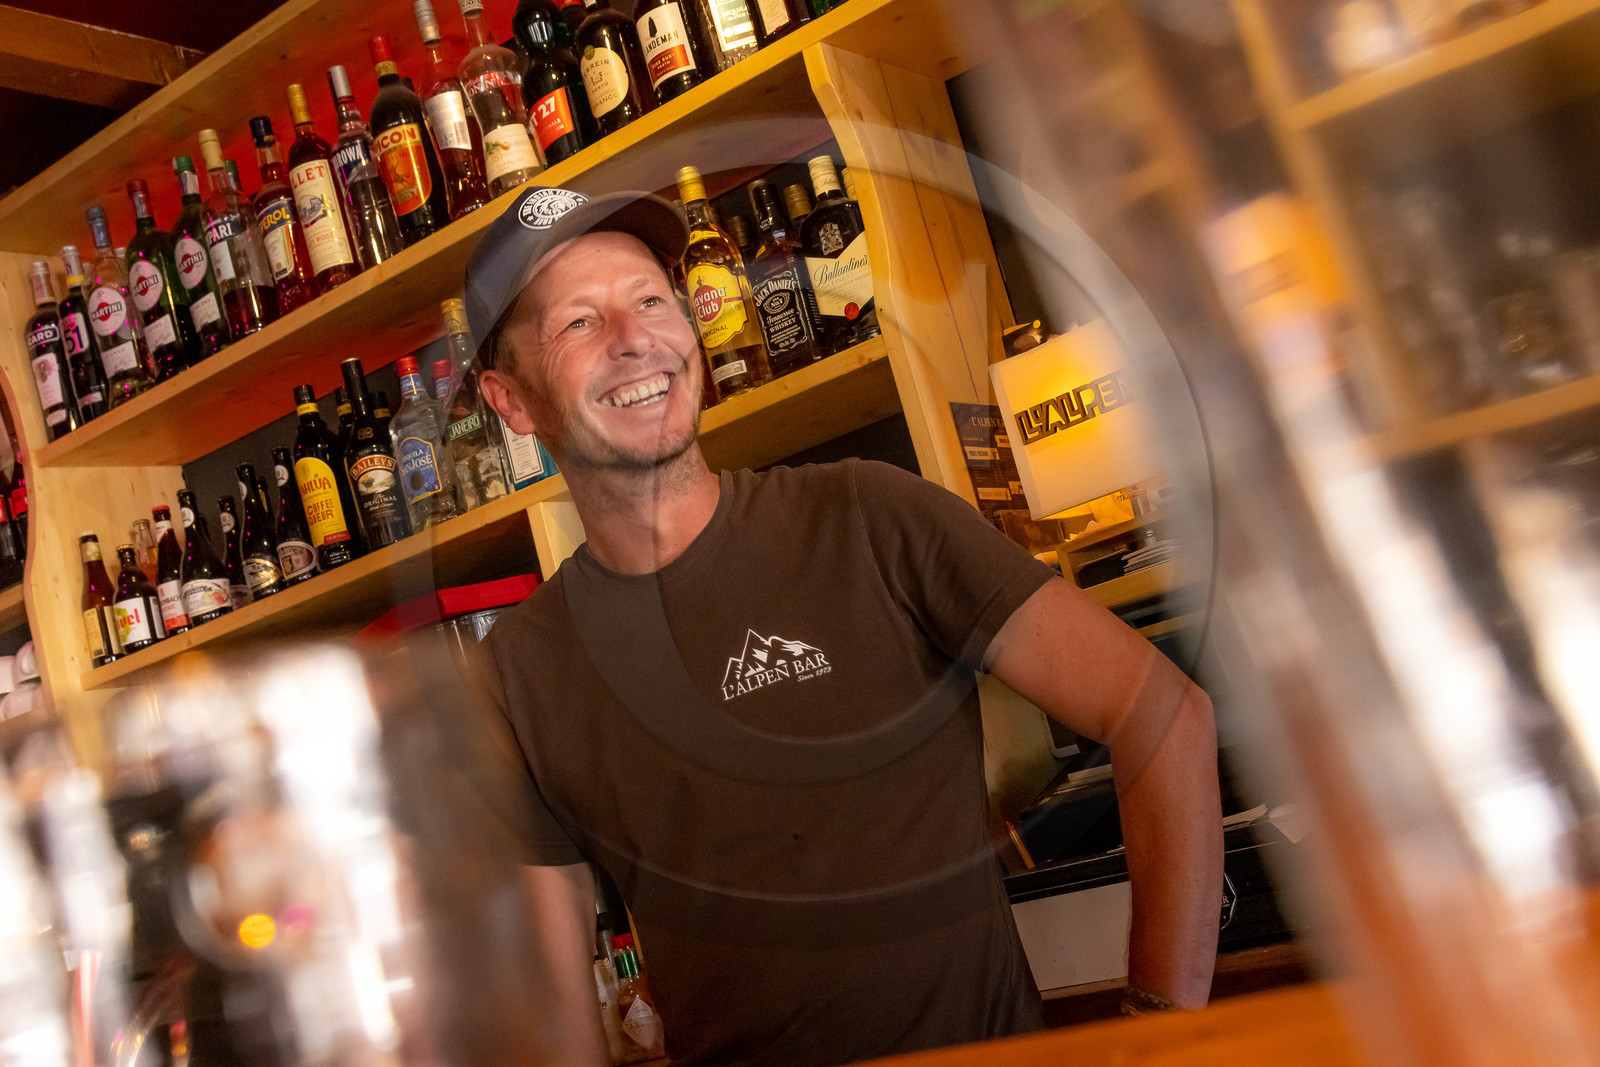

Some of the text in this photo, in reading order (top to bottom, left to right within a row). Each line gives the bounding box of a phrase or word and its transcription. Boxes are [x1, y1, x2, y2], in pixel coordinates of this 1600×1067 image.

[537, 96, 555, 118] 27
[814, 254, 869, 288] Ballantine's
[754, 277, 797, 307] JACK DANIEL'S
[697, 301, 719, 319] Club
[766, 308, 795, 325] Tennessee
[769, 316, 796, 333] WHISKEY
[64, 325, 84, 353] 51
[450, 415, 481, 438] JANEIRO
[352, 457, 392, 477] BAILEYS
[307, 498, 335, 515] COFFEE
[364, 495, 397, 509] ORIGINAL
[721, 652, 830, 700] L'ALPEN BAR
